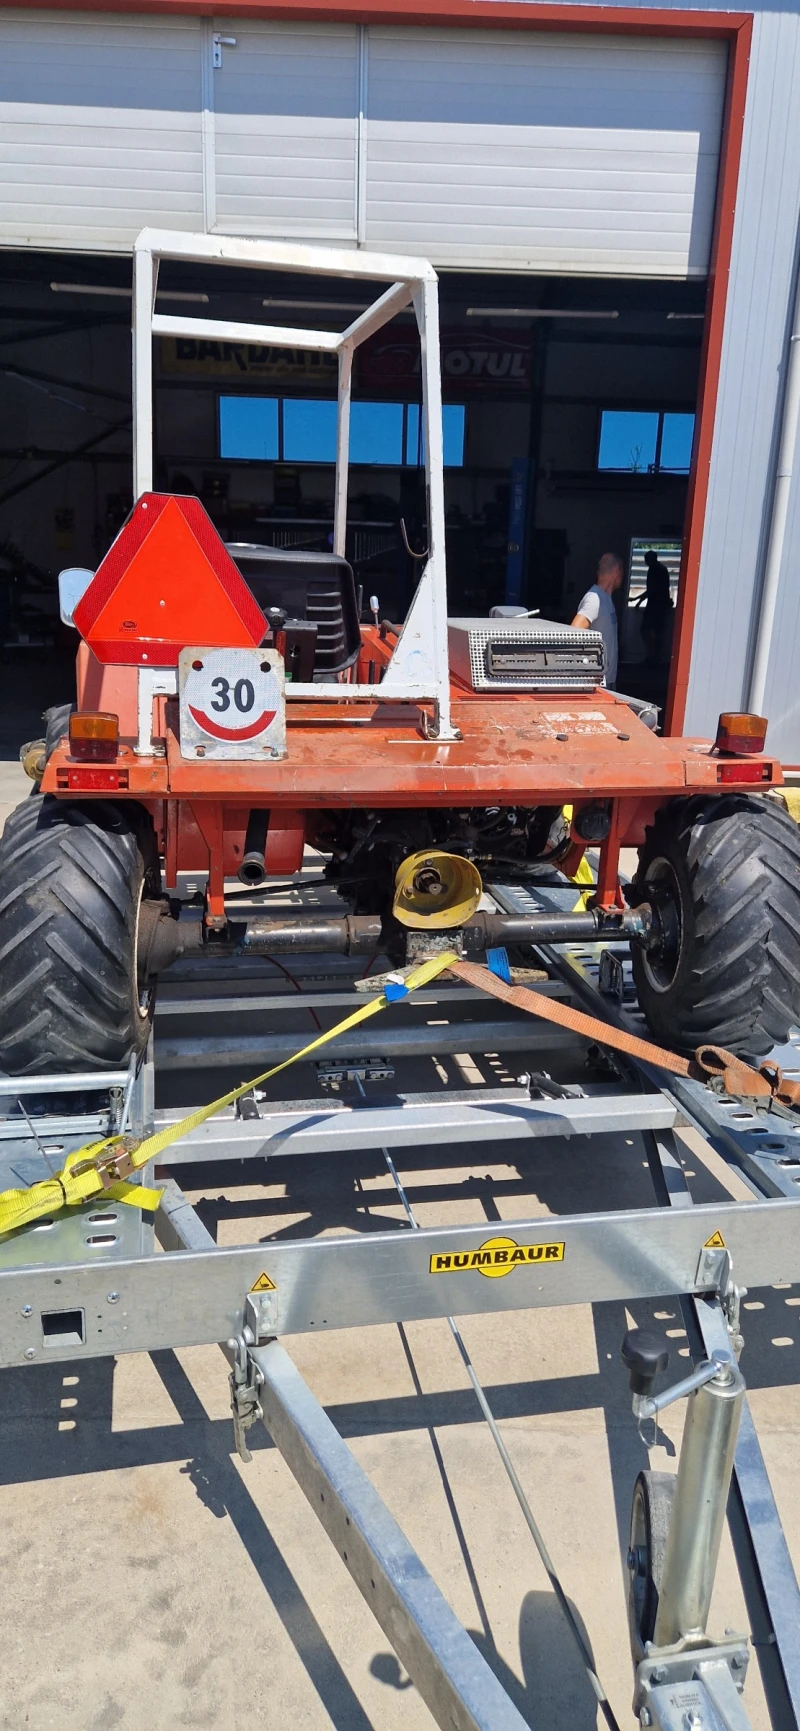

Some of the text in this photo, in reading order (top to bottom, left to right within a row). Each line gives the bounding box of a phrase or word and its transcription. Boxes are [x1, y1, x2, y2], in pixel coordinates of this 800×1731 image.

[413, 349, 526, 377] OTUL
[210, 676, 255, 713] 30
[436, 1246, 560, 1269] HUMBAUR
